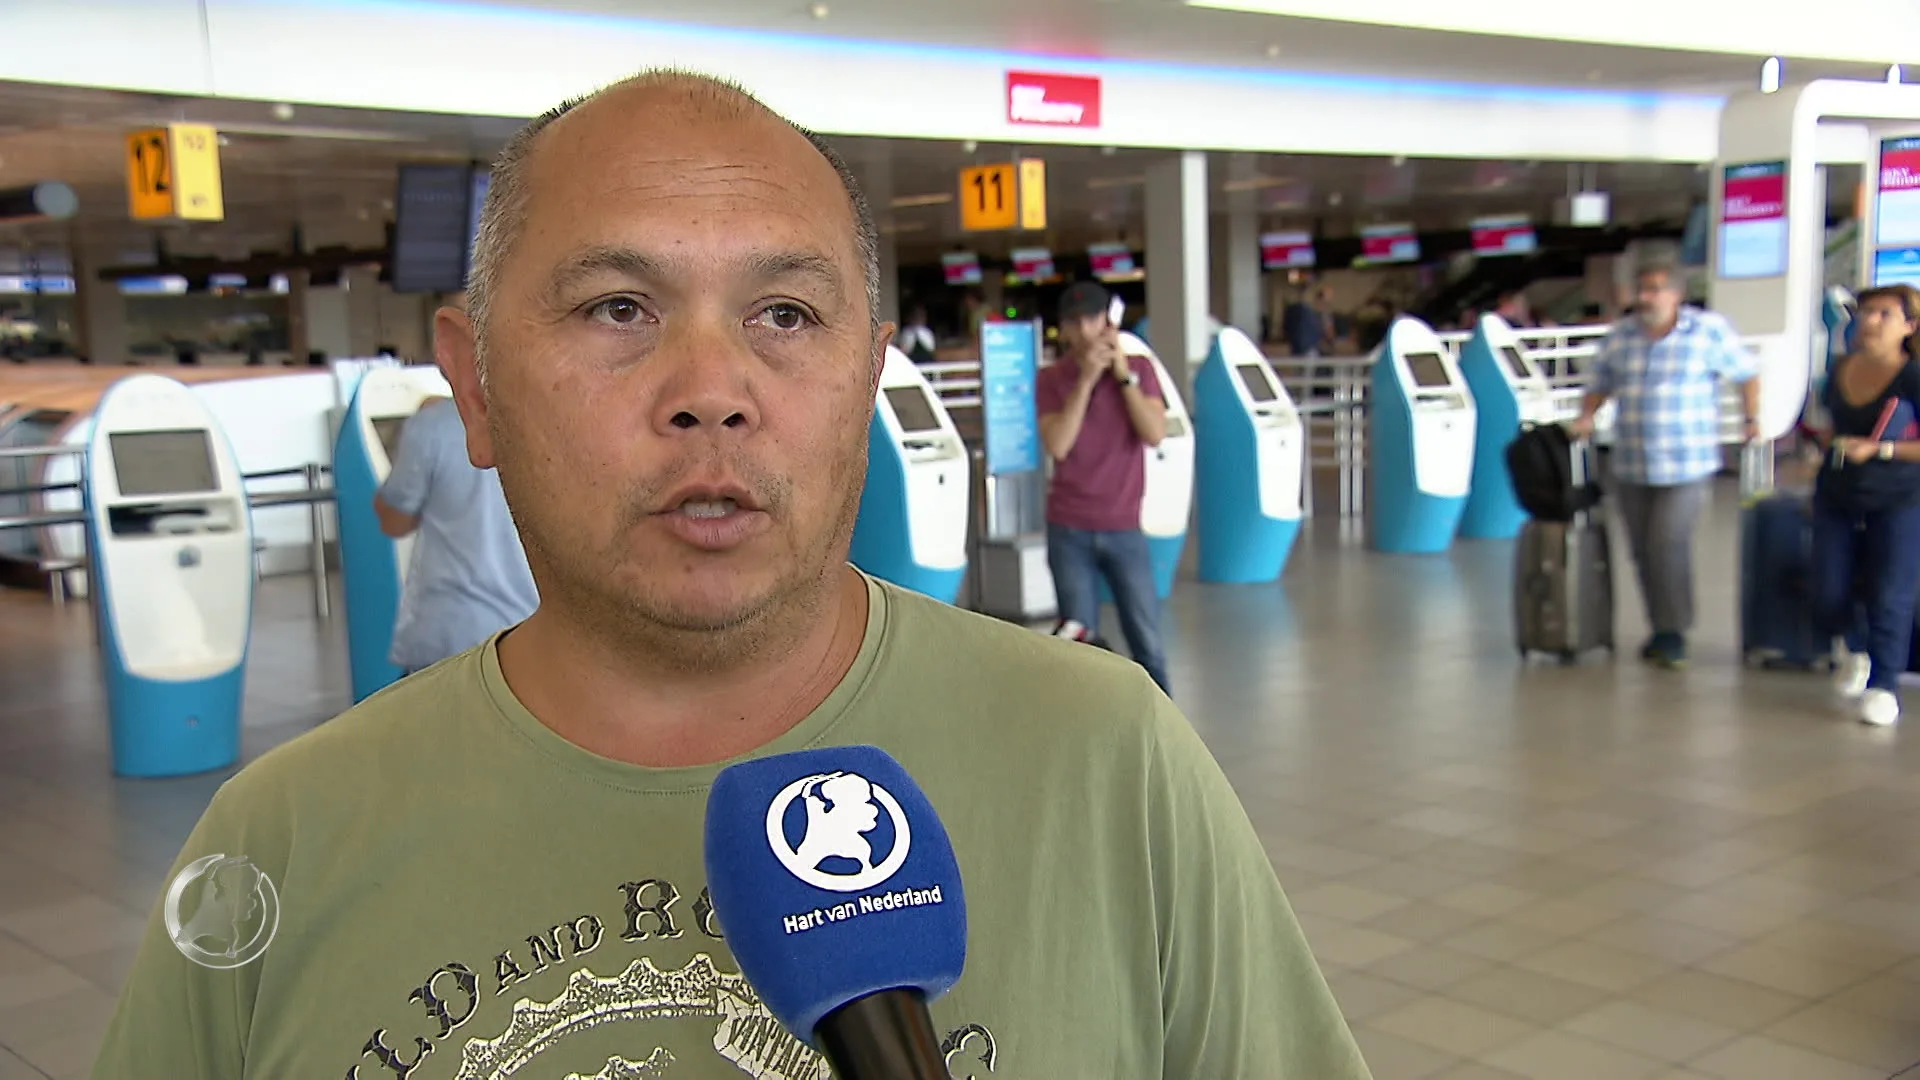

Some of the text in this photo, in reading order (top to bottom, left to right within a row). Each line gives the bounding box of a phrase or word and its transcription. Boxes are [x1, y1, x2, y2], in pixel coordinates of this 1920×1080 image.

[134, 134, 168, 193] 12
[974, 172, 1003, 211] 11
[783, 885, 943, 934] Hart van Nederland
[493, 915, 605, 996] AND
